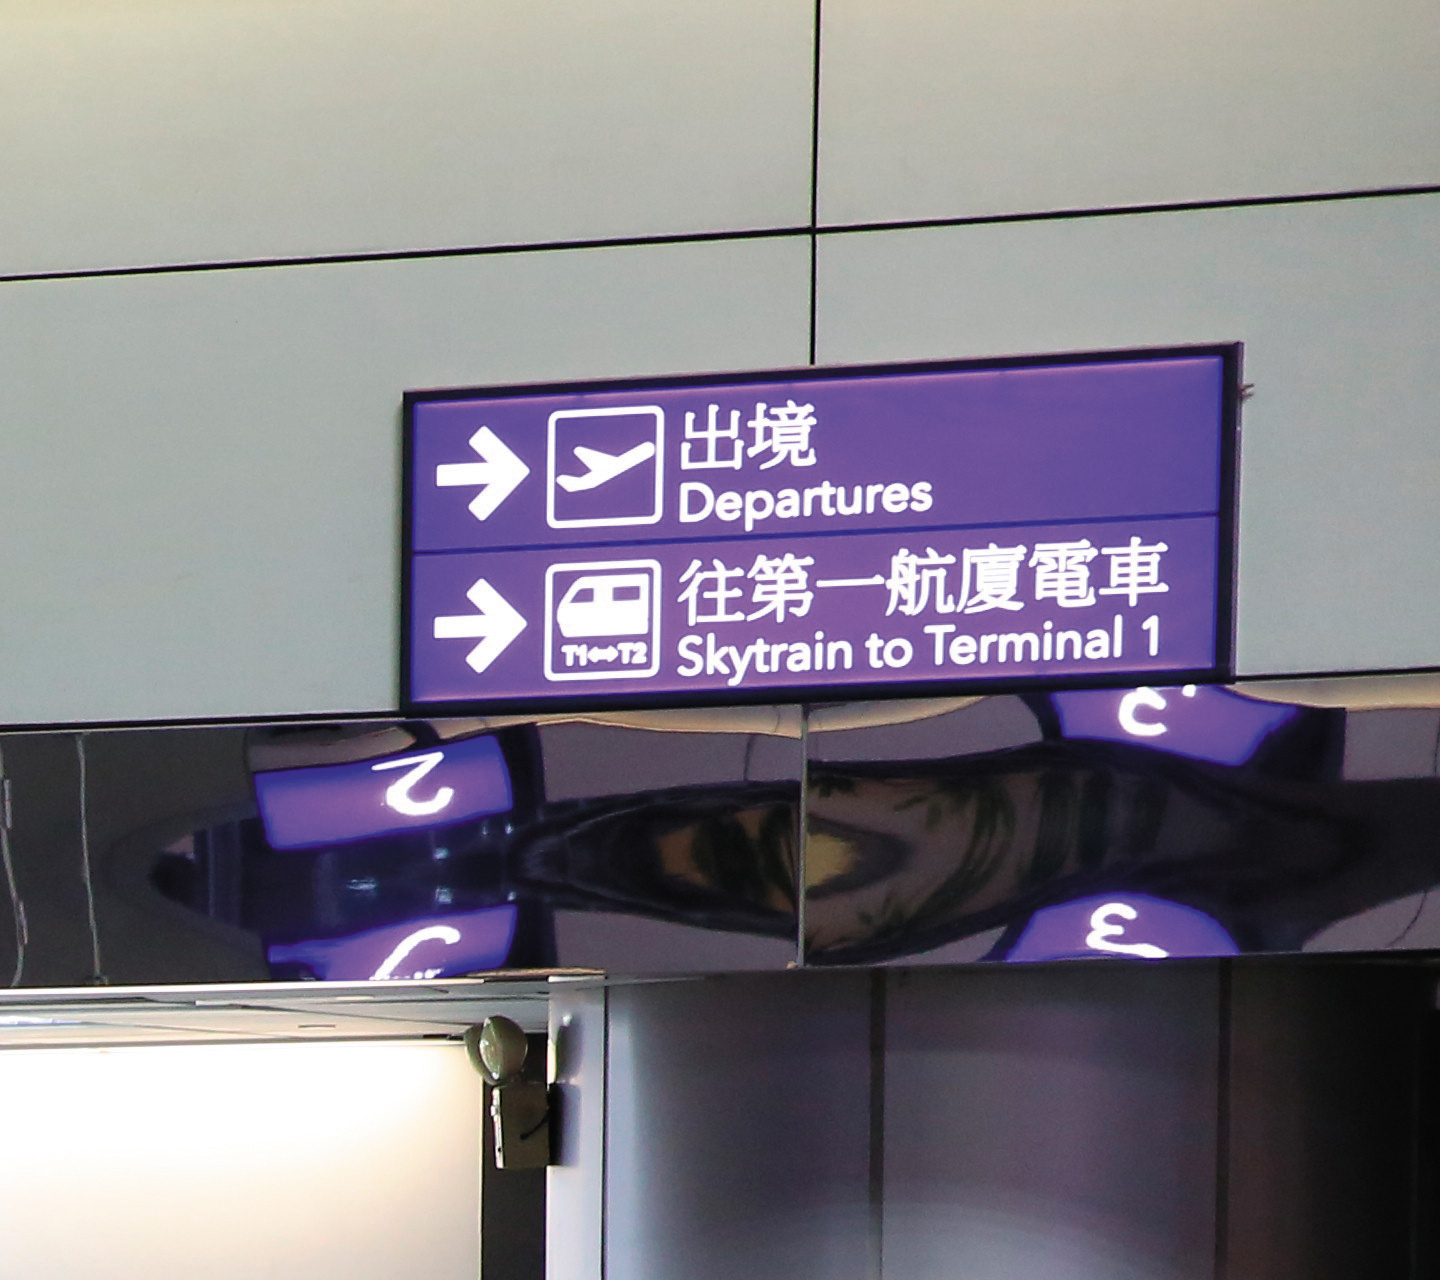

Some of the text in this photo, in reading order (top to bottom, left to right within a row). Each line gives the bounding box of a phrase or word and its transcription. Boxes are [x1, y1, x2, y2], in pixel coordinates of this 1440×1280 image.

[679, 400, 818, 470] 出境
[678, 480, 934, 532] Departures
[676, 536, 1170, 627] 往第一航廈電車
[676, 613, 1160, 687] Skytrain to Terminal 1
